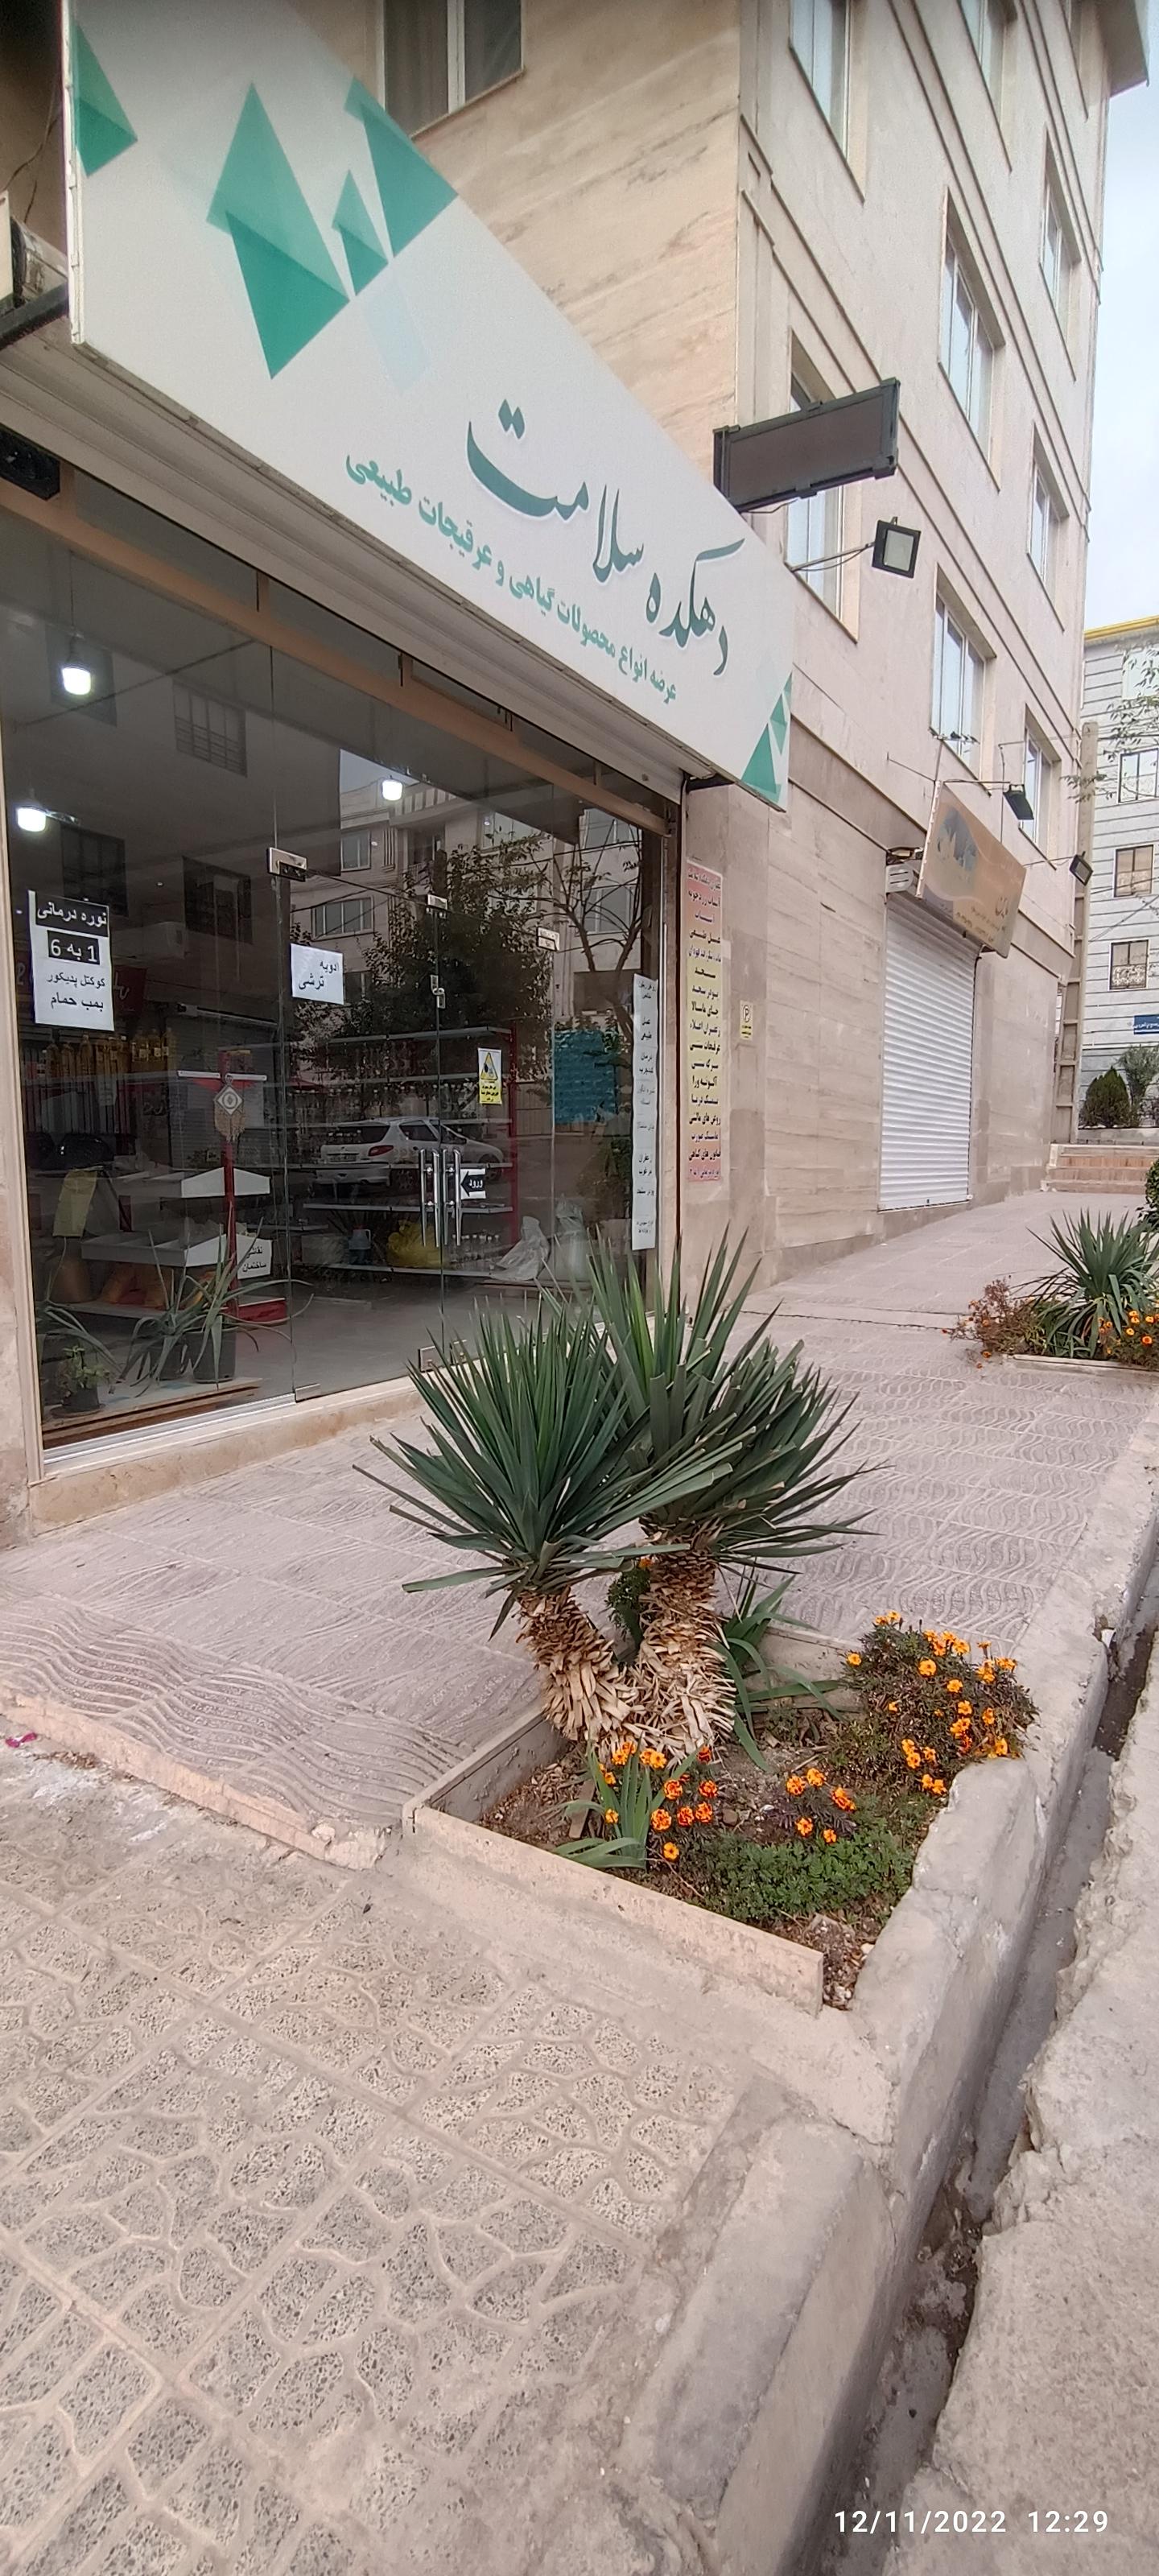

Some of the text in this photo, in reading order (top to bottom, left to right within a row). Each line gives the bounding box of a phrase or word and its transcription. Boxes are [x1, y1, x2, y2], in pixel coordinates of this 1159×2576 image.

[467, 399, 745, 676] دهکده سلامت
[346, 455, 677, 704] عرضه انواع محصولات گیاهی و عرقیجات طبیعی
[37, 902, 107, 927] نوره درمانی
[51, 939, 97, 963] 1 به 6
[320, 960, 340, 974] ادویه
[80, 975, 106, 989] کوکتل
[298, 972, 324, 990] ترشی
[51, 992, 105, 1012] بمب حمام
[468, 1179, 483, 1189] ورود
[242, 1261, 267, 1273] ساختمان
